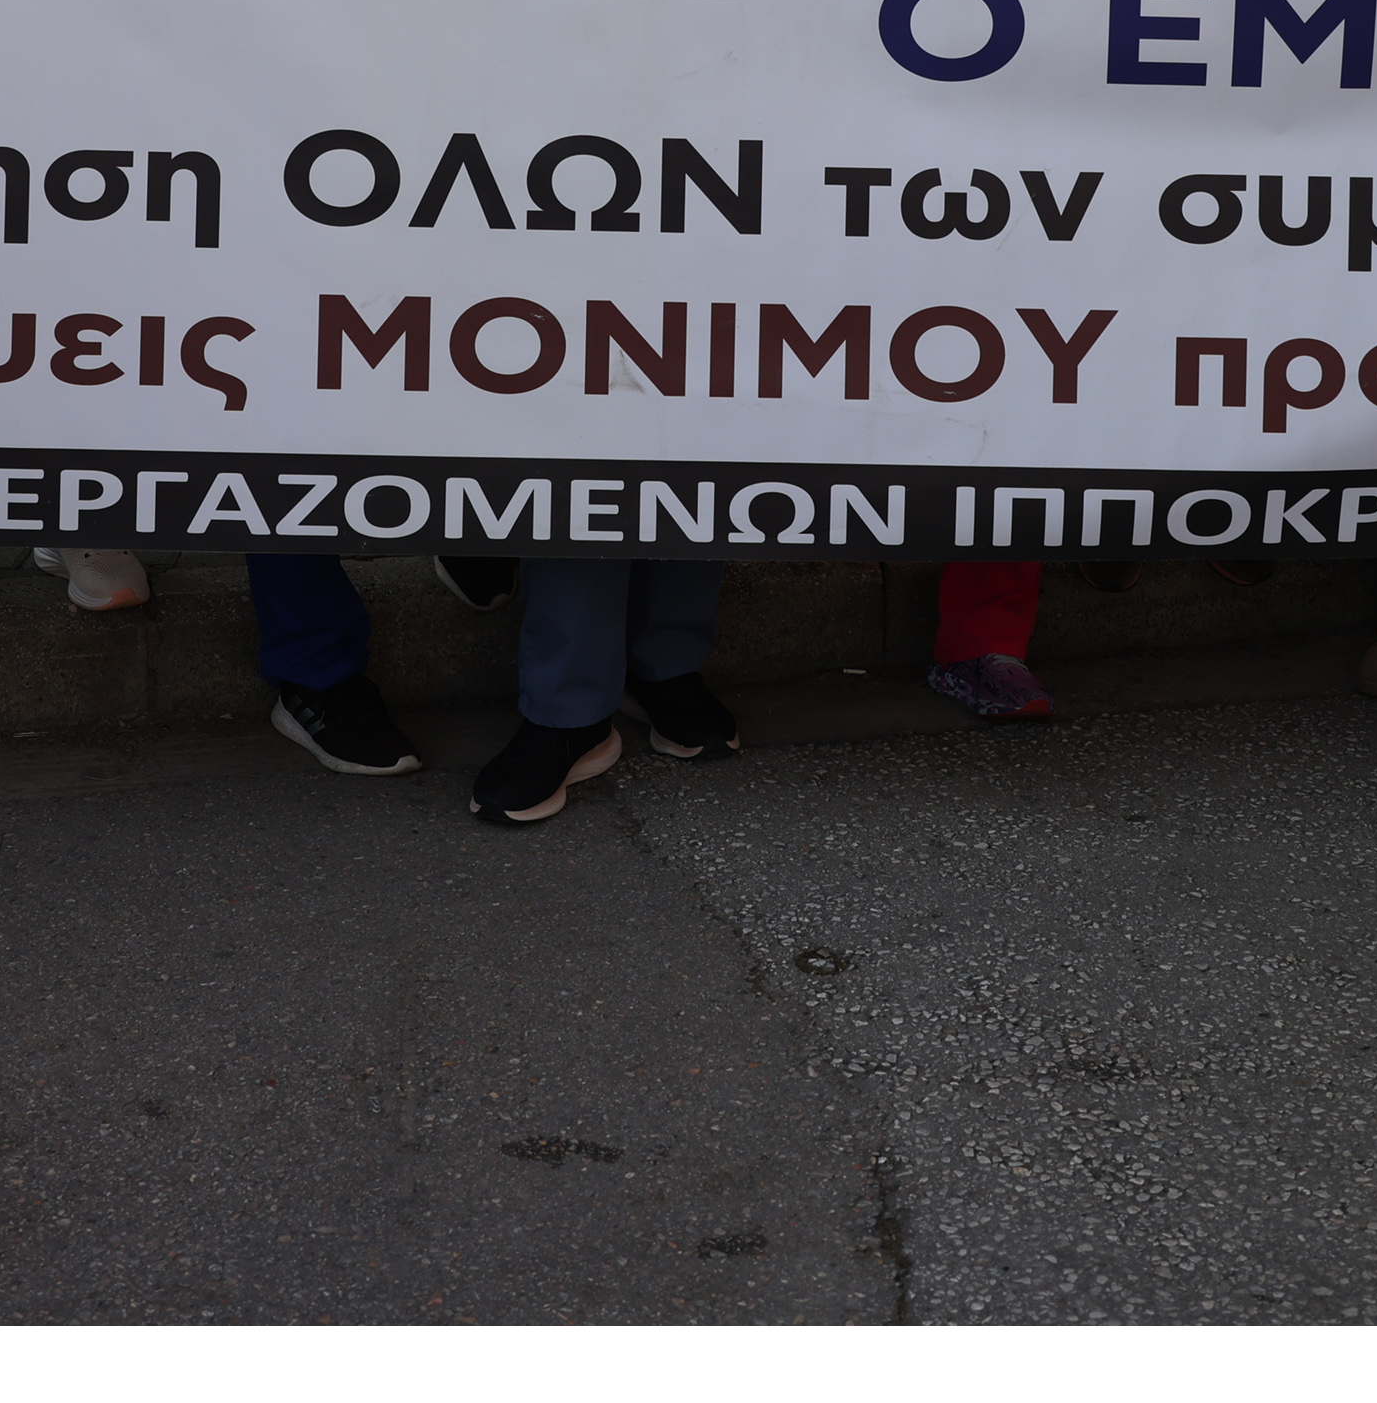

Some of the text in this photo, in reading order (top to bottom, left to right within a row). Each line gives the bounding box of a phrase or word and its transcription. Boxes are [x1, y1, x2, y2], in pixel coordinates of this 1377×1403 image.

[283, 129, 763, 235] ΟΛΩΝ
[824, 166, 1104, 242] των
[317, 294, 1119, 403] ΜΟΝΙΜΟΥ
